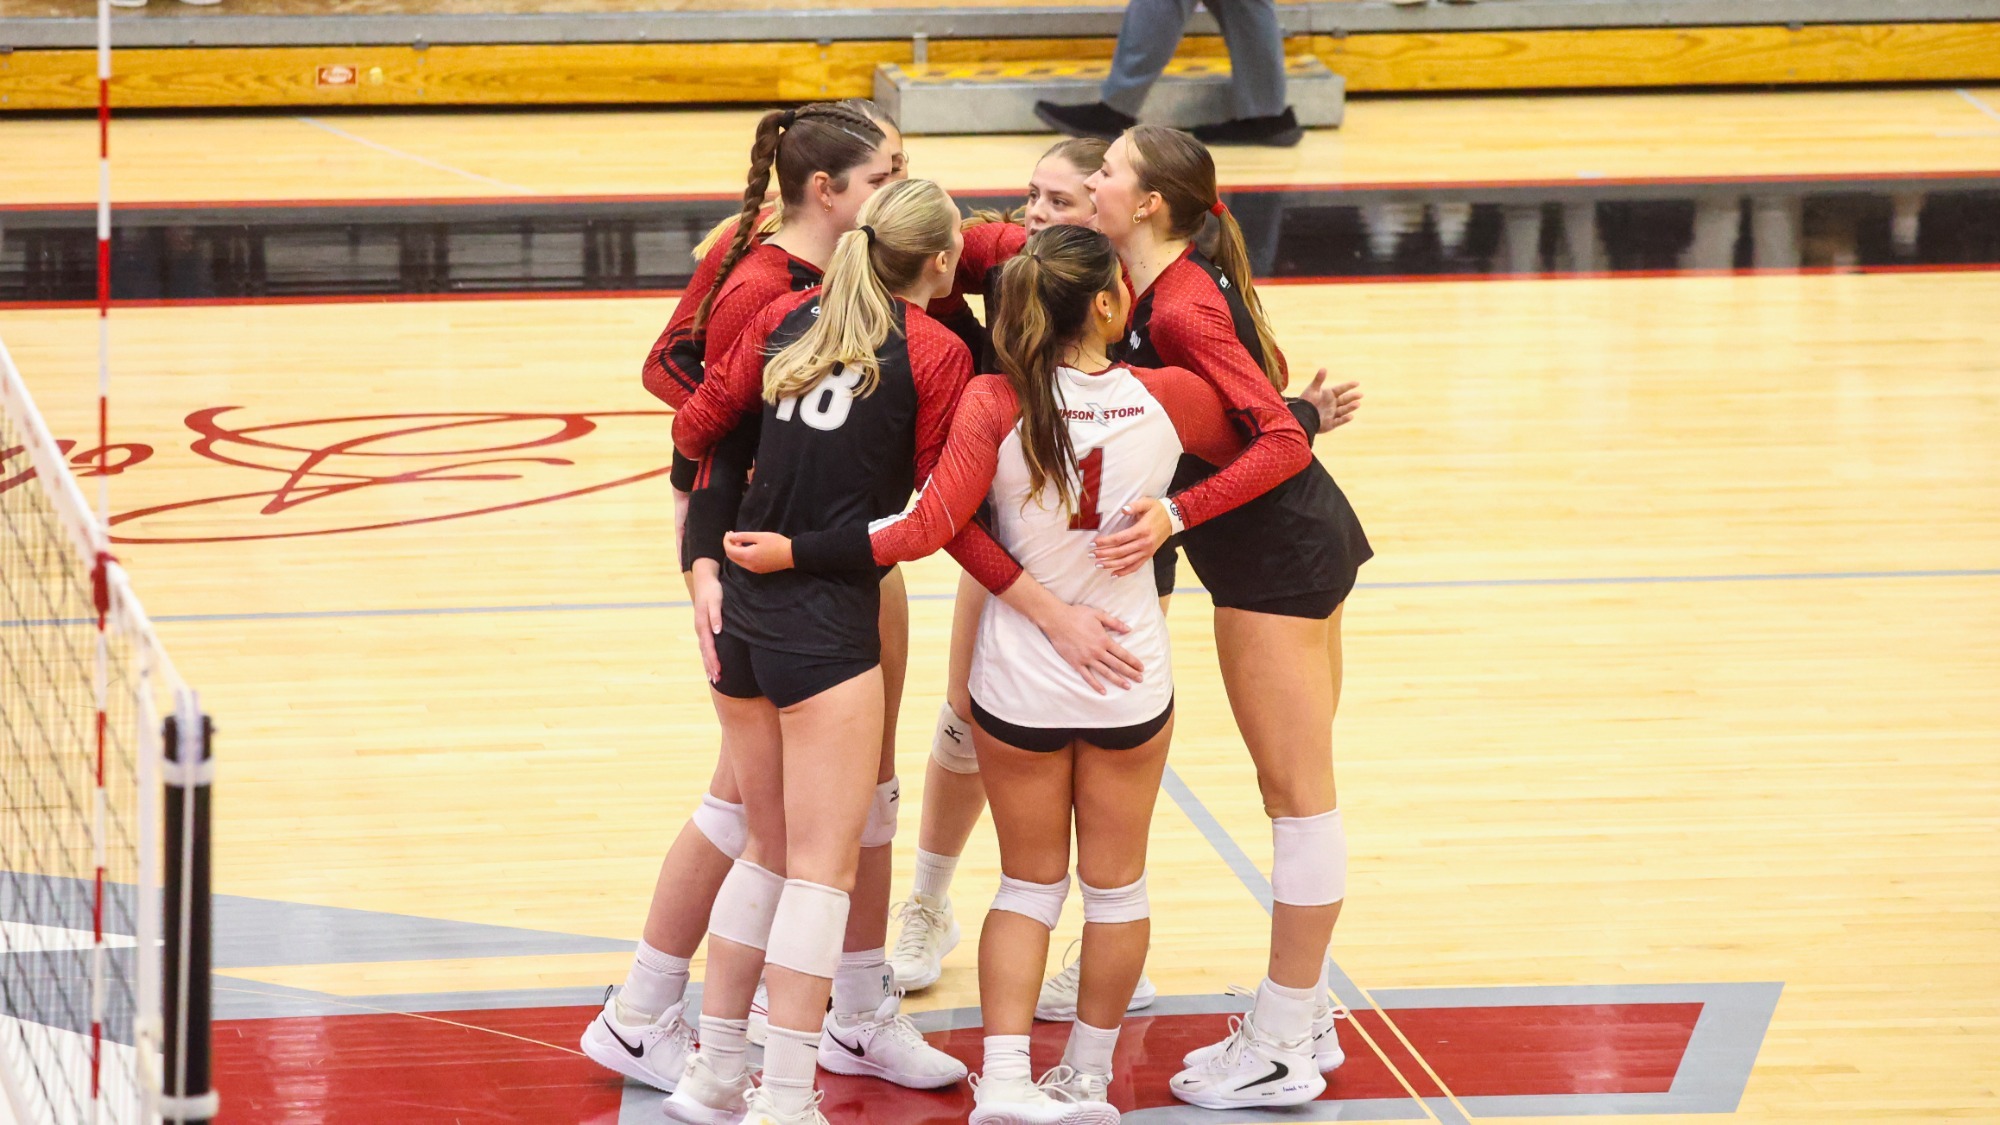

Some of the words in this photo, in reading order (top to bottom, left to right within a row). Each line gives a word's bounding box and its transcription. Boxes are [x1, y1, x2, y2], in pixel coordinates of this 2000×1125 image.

[1060, 408, 1095, 421] MSON
[1103, 406, 1145, 419] STORM
[1067, 446, 1105, 531] 1
